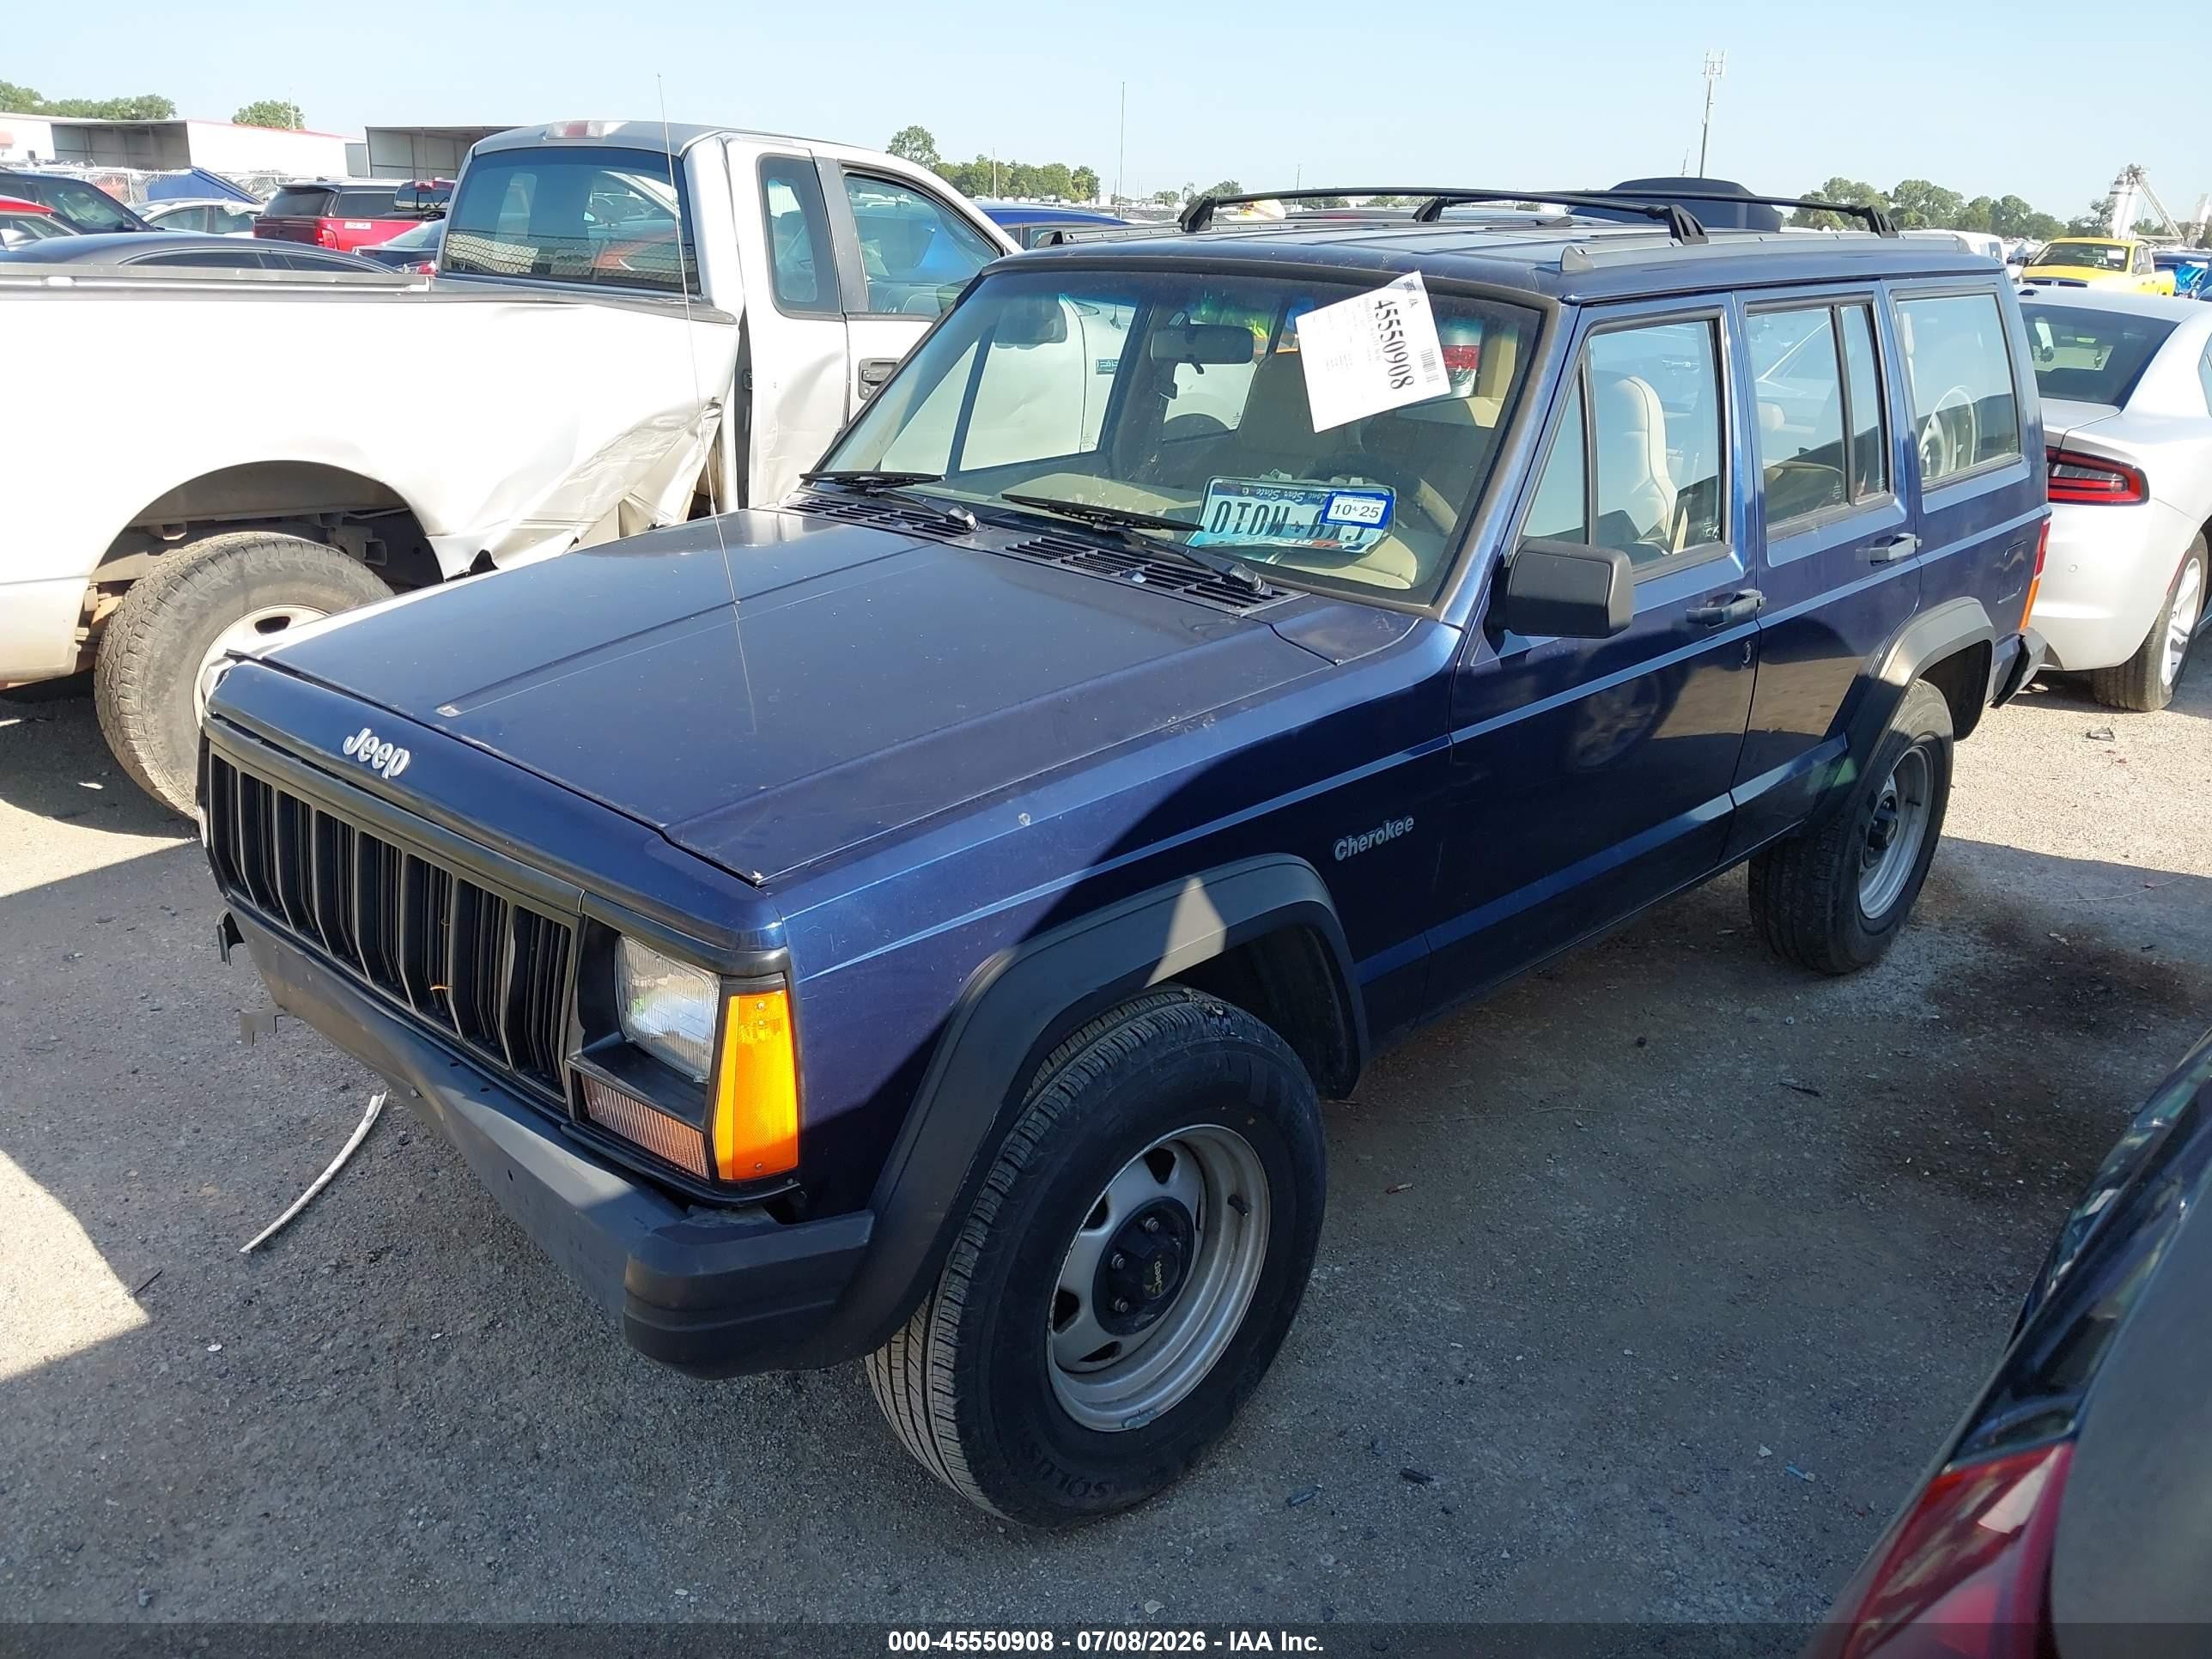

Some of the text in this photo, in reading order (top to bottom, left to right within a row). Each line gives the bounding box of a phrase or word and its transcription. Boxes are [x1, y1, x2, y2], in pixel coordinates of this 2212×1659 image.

[1374, 299, 1415, 390] 45550908
[1255, 487, 1280, 501] State
[1283, 489, 1306, 502] Star
[342, 727, 411, 780] Jeep
[1334, 815, 1414, 860] Cherokee
